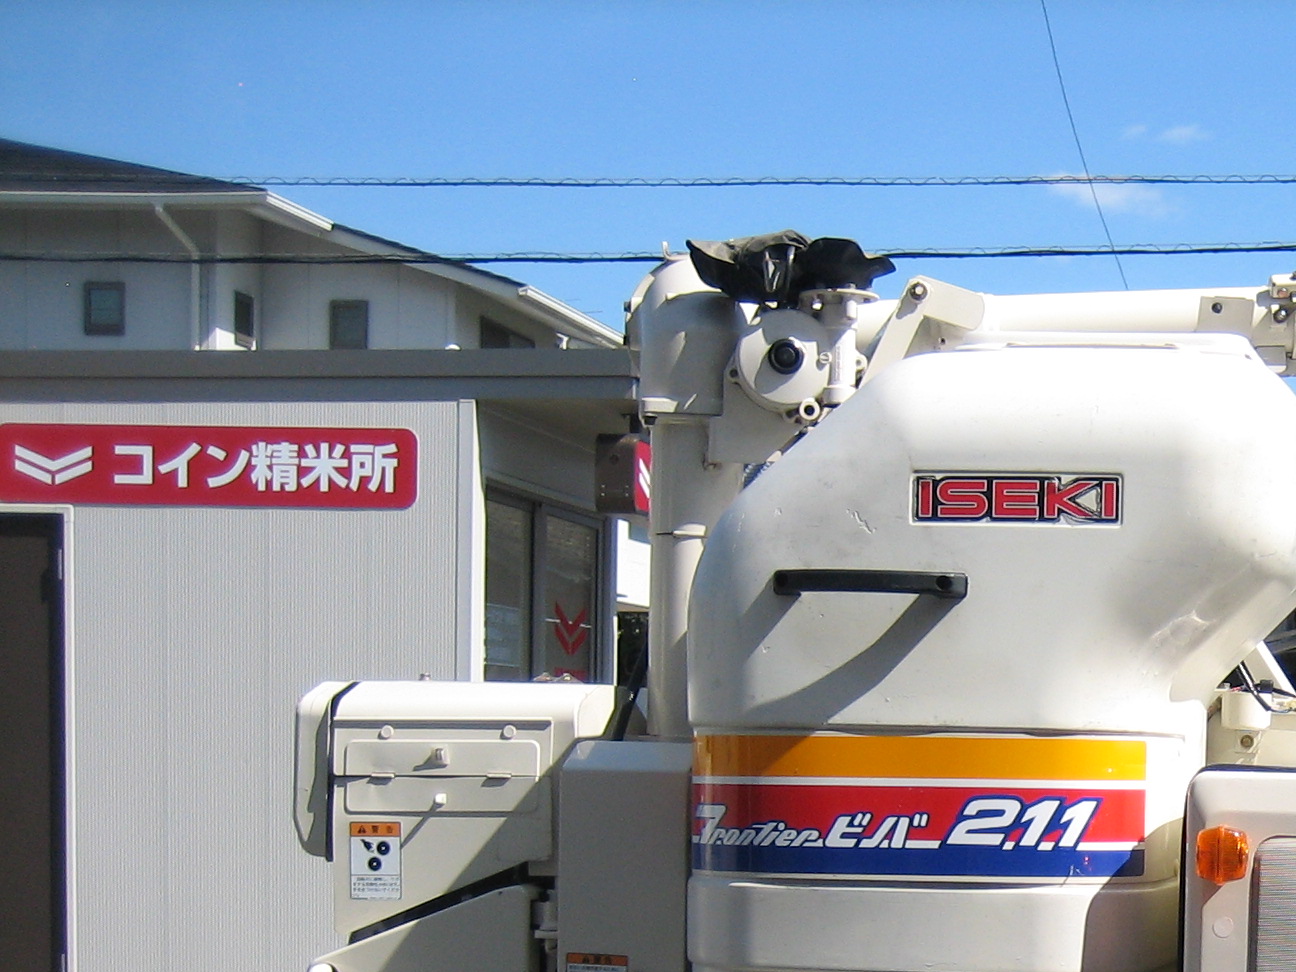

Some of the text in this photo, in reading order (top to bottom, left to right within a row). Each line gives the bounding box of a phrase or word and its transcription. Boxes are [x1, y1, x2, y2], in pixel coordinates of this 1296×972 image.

[113, 441, 399, 493] コイン精米所
[918, 479, 1117, 519] ISEKI
